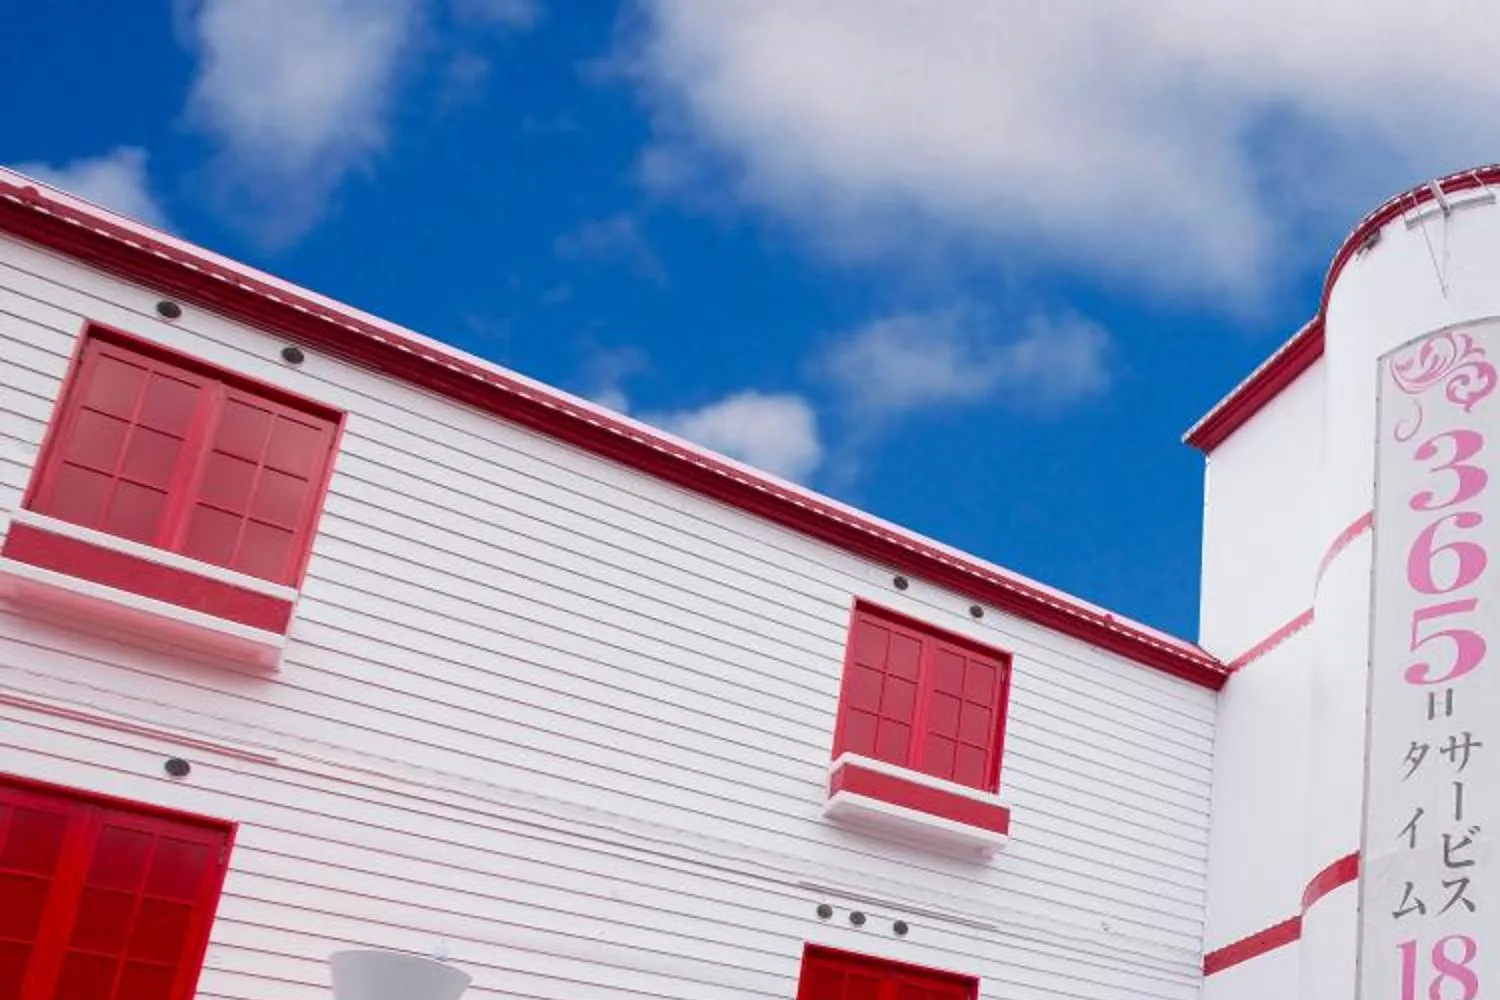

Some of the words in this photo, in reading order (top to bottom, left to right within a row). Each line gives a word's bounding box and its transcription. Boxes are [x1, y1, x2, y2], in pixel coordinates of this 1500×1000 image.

[1391, 741, 1430, 919] タイム
[1437, 732, 1483, 916] サービス
